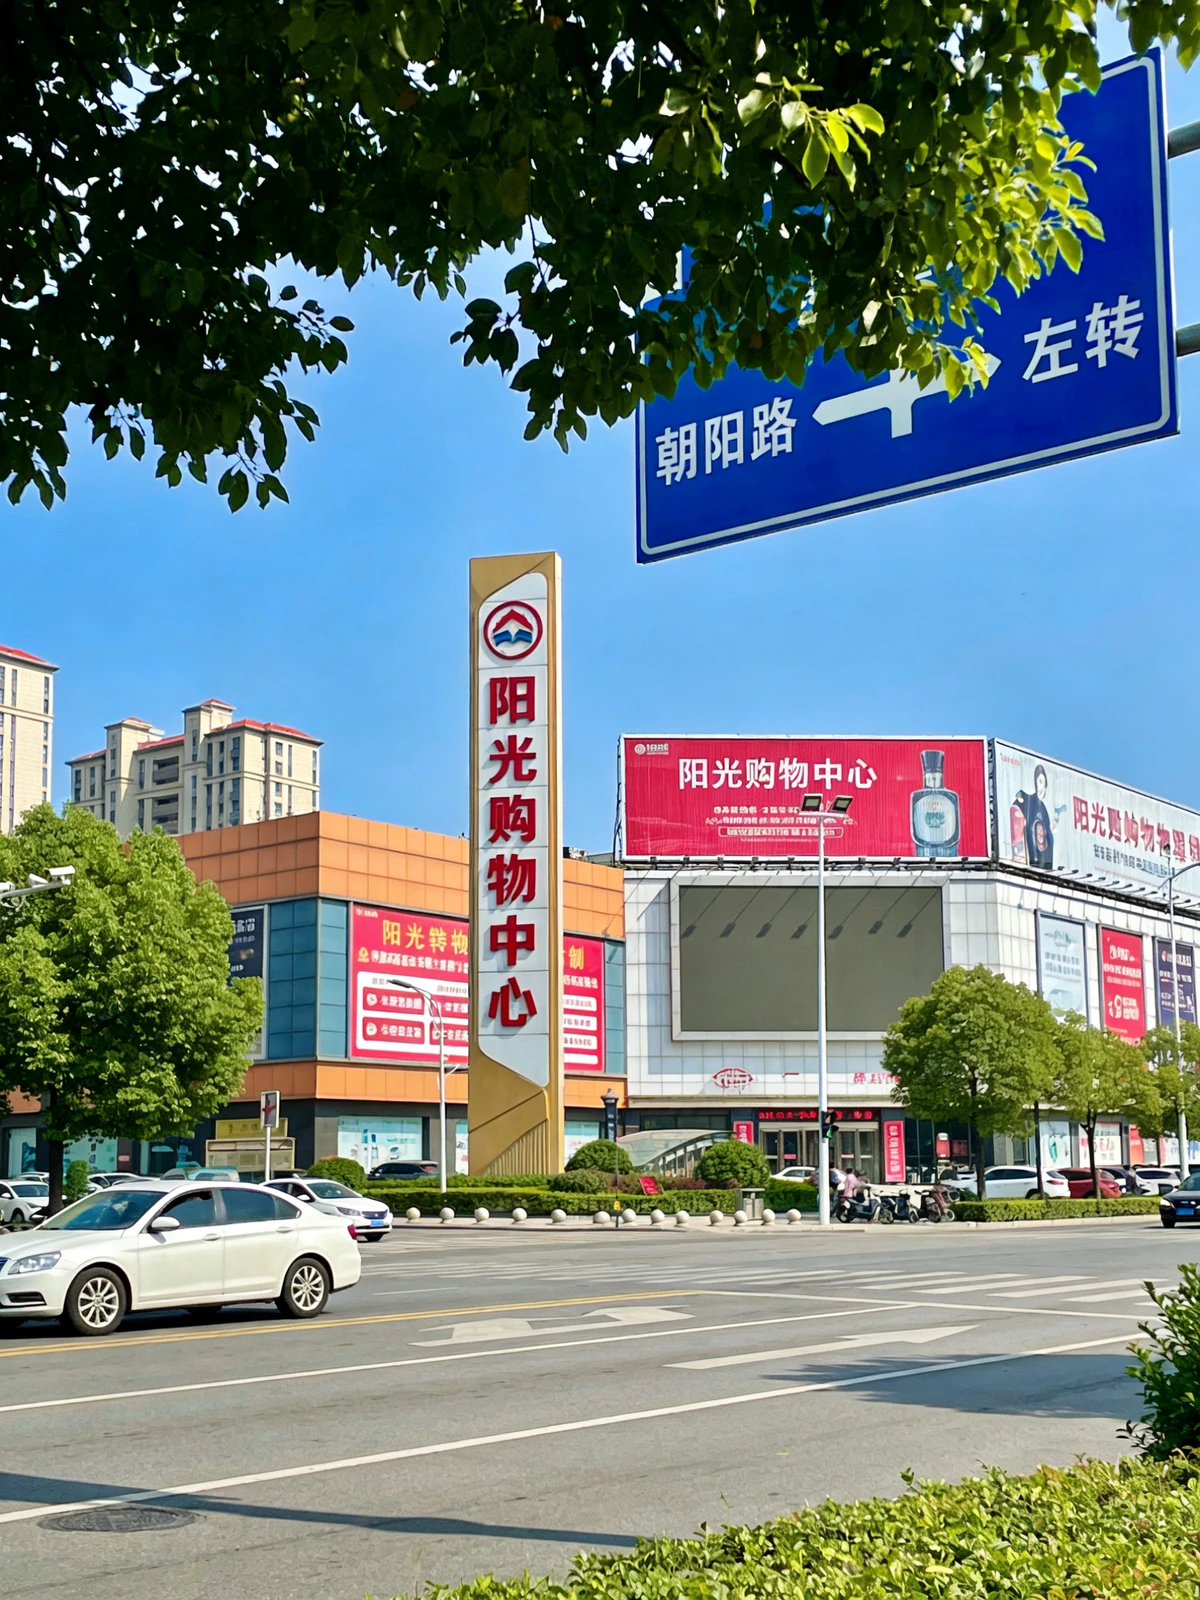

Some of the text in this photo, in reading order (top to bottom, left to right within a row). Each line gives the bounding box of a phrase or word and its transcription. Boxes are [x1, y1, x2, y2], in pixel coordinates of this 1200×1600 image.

[1022, 295, 1144, 384] 左转
[655, 397, 797, 486] 朝阳路
[679, 758, 877, 790] 阳光购物中心
[488, 677, 537, 1028] 阳光购物中心
